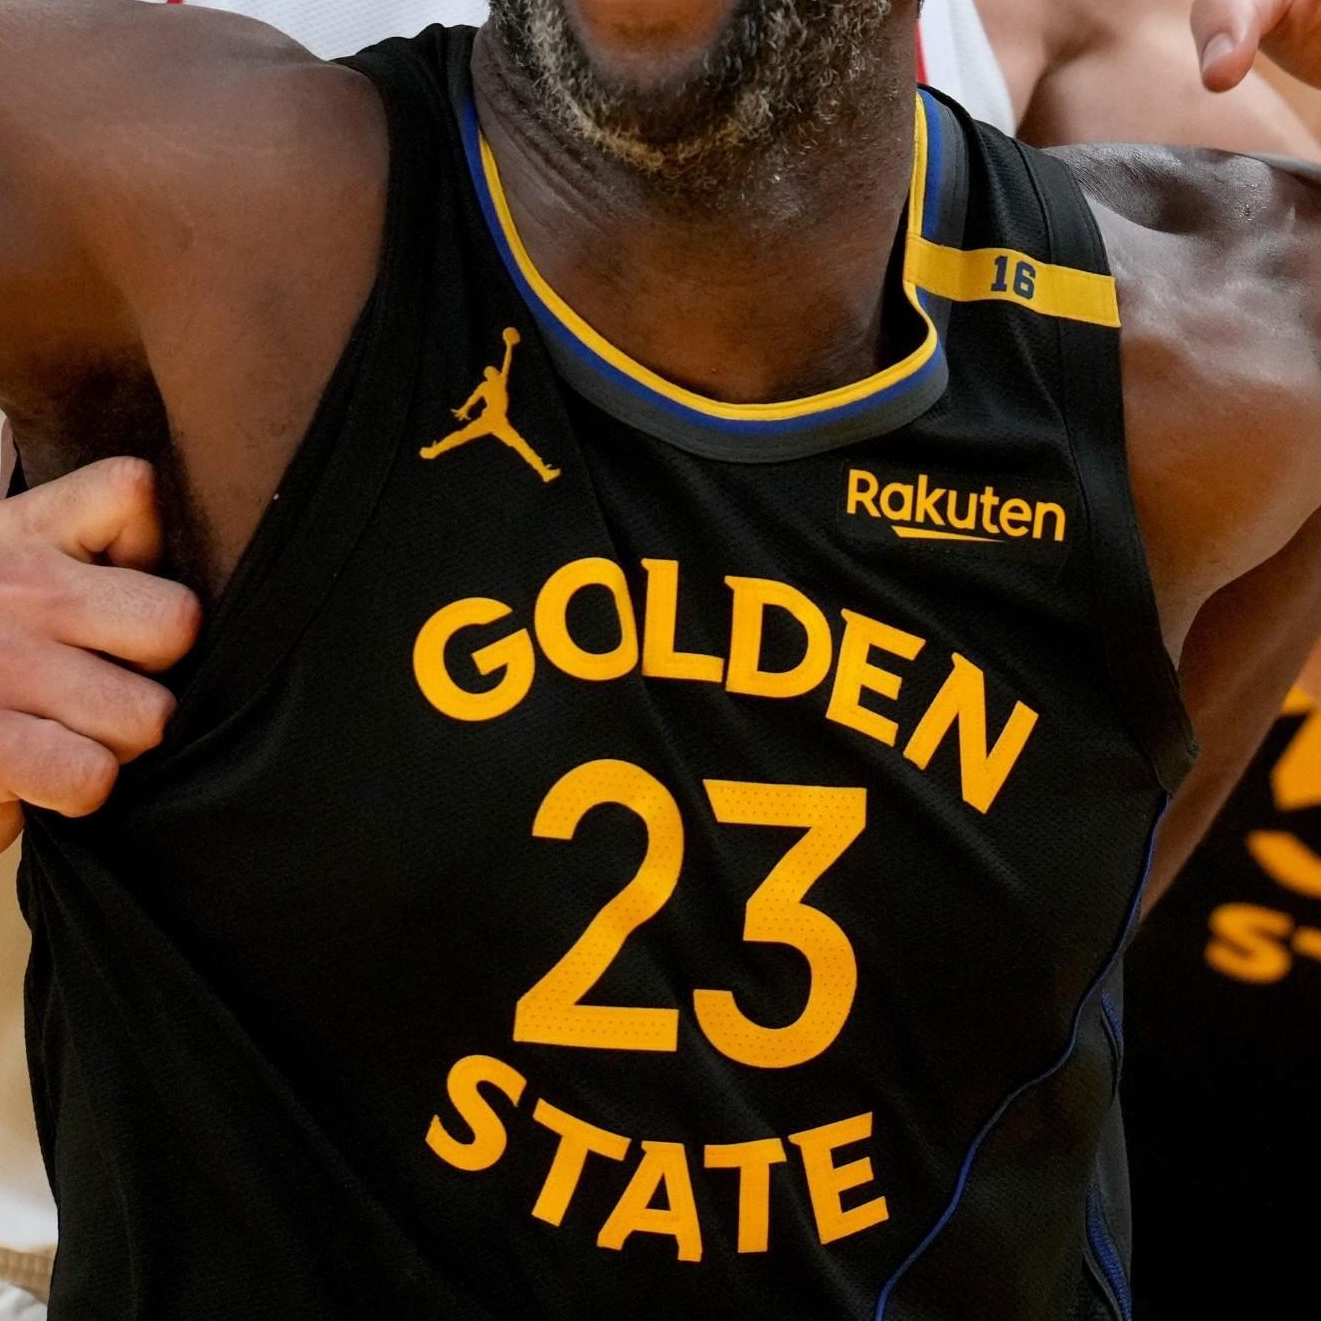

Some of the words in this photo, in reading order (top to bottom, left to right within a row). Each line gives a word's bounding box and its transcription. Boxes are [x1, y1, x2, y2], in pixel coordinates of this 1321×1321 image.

[990, 255, 1036, 300] 16
[846, 468, 1066, 542] Rakuten
[412, 556, 1039, 815] GOLDEN
[513, 758, 867, 1069] 23
[424, 1054, 889, 1263] STATE
